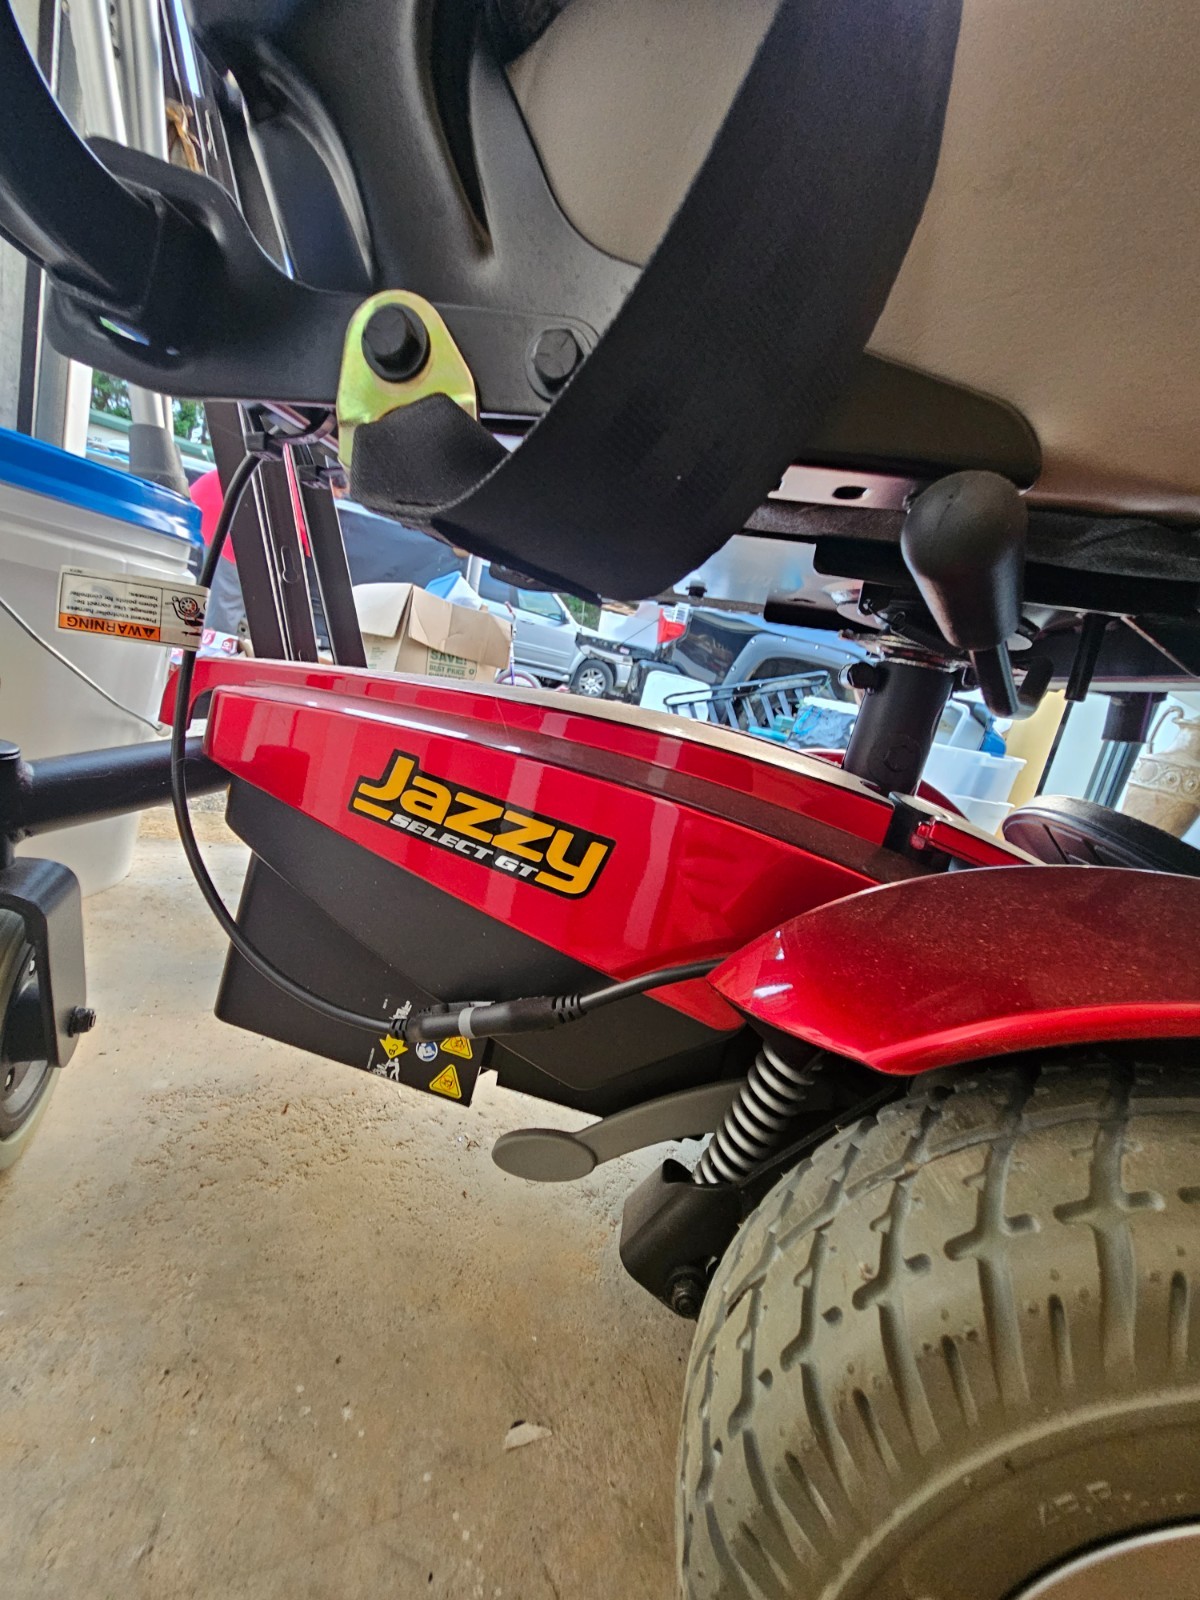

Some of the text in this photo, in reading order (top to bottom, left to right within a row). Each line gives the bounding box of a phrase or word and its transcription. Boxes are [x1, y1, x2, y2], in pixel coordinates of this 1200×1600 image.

[69, 590, 103, 599] controller
[86, 600, 111, 609] correct
[128, 606, 157, 616] damage.
[66, 605, 157, 624] Prevent controller harness
[66, 616, 142, 637] WARNING
[431, 649, 467, 665] SAVE!
[429, 664, 445, 672] BEST
[446, 667, 465, 676] PRICE
[352, 755, 609, 894] Jazzy
[390, 813, 539, 878] SELECT GT
